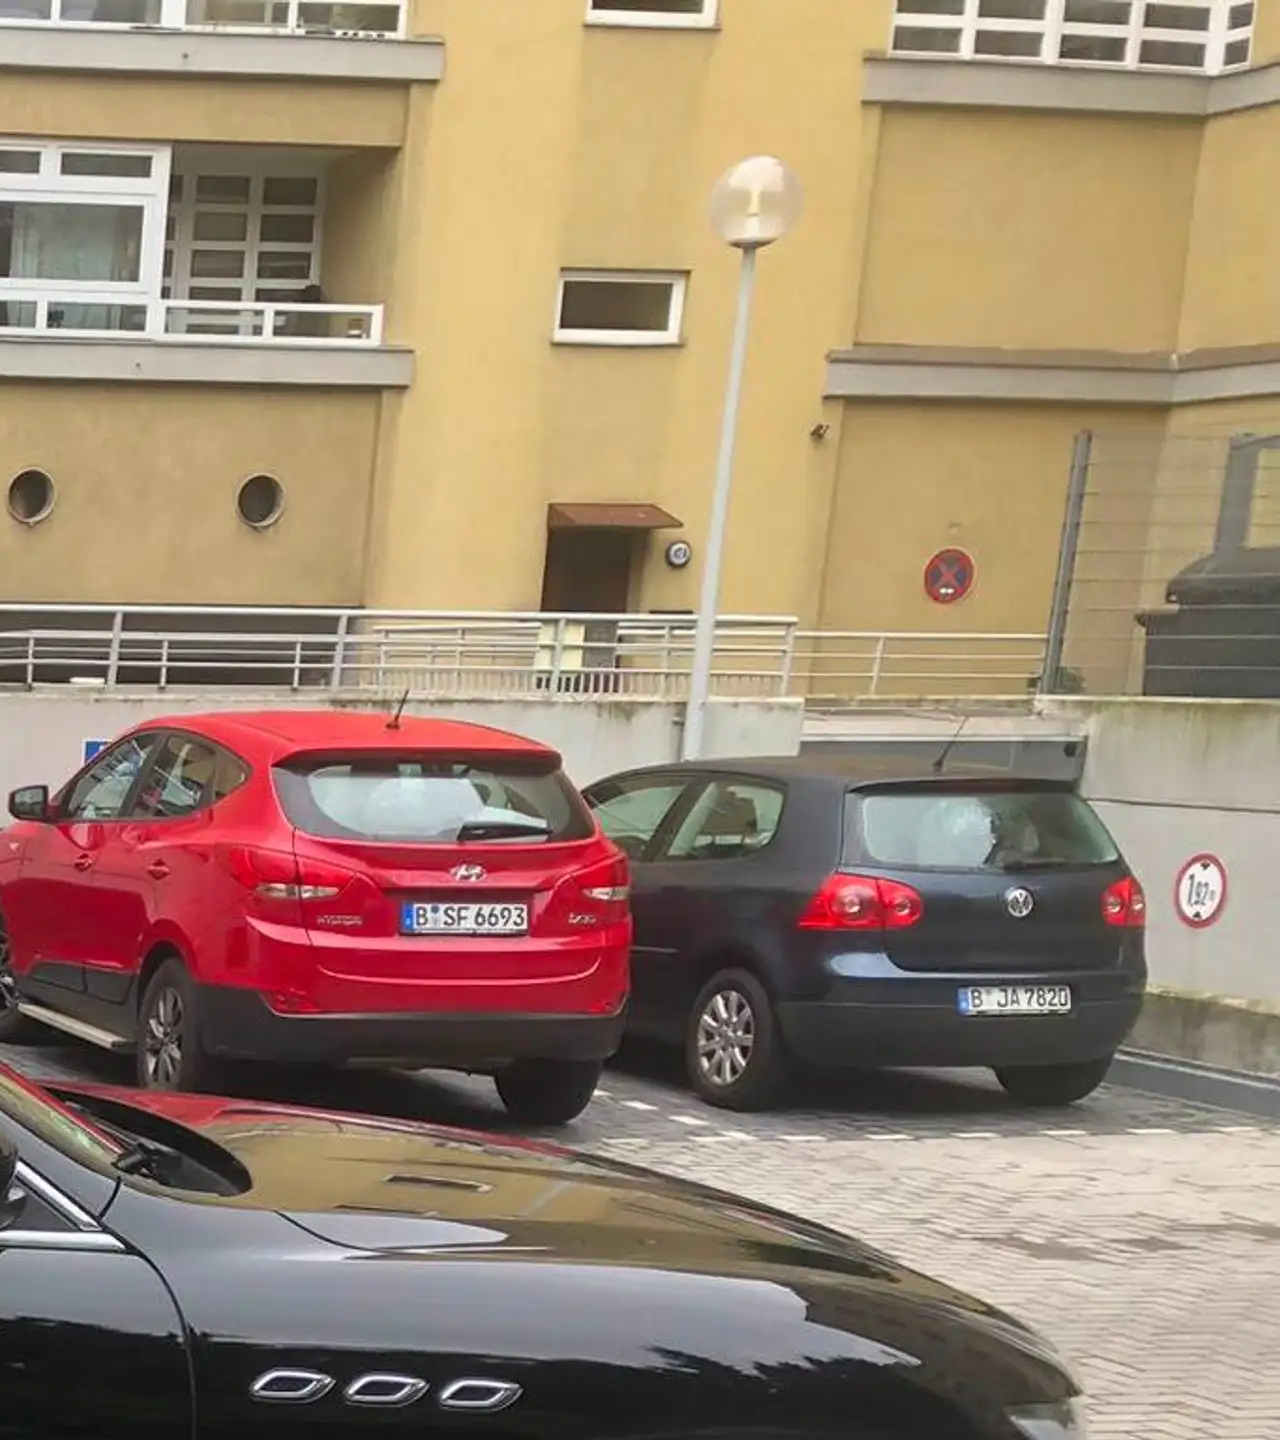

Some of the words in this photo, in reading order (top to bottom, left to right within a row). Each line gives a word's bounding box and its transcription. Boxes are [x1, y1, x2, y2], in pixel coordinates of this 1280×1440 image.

[416, 906, 428, 926] B
[443, 906, 470, 927] SF
[474, 906, 525, 927] 6693
[971, 988, 983, 1008] B
[997, 987, 1020, 1008] JA
[1024, 987, 1069, 1007] 7820
